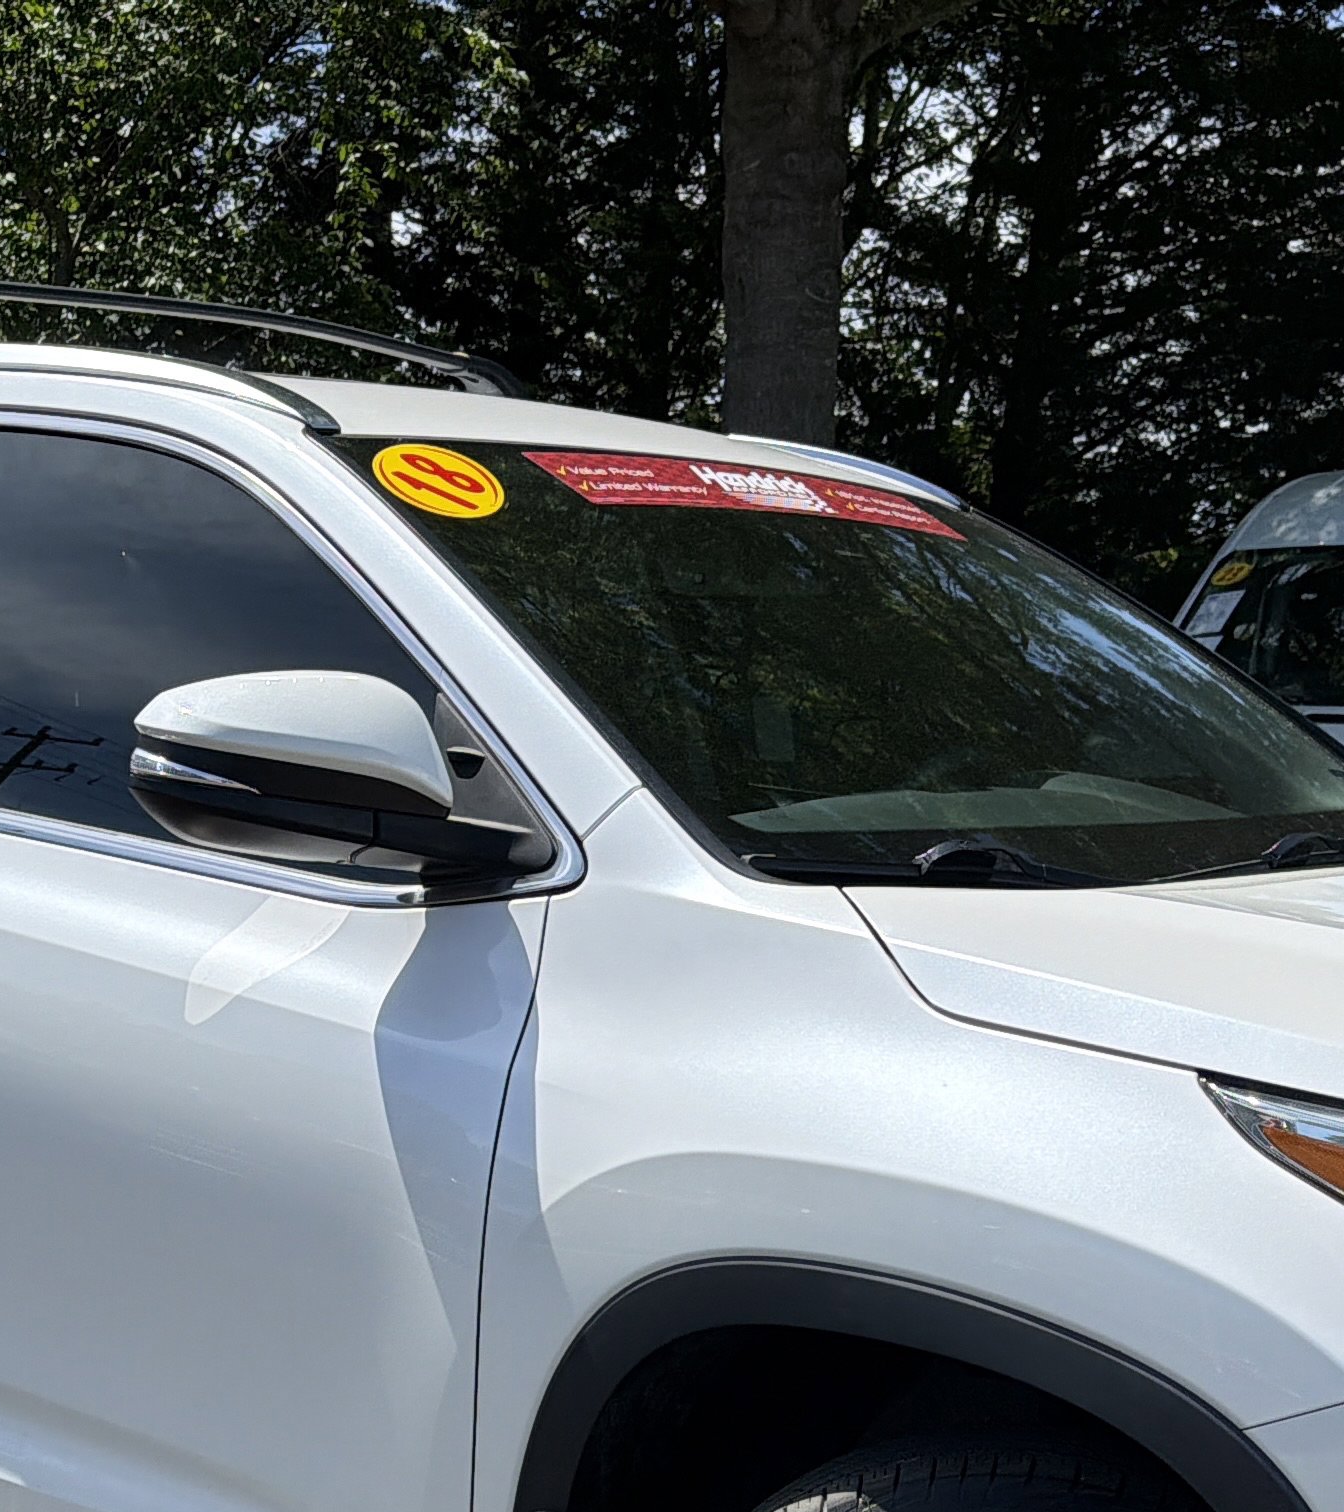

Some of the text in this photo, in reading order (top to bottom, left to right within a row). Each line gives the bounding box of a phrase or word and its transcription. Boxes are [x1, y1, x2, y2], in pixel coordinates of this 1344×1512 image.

[391, 453, 486, 510] 18
[568, 465, 655, 478] Value Priced
[689, 464, 816, 497] Hendrick
[589, 480, 708, 496] Limited Warranty
